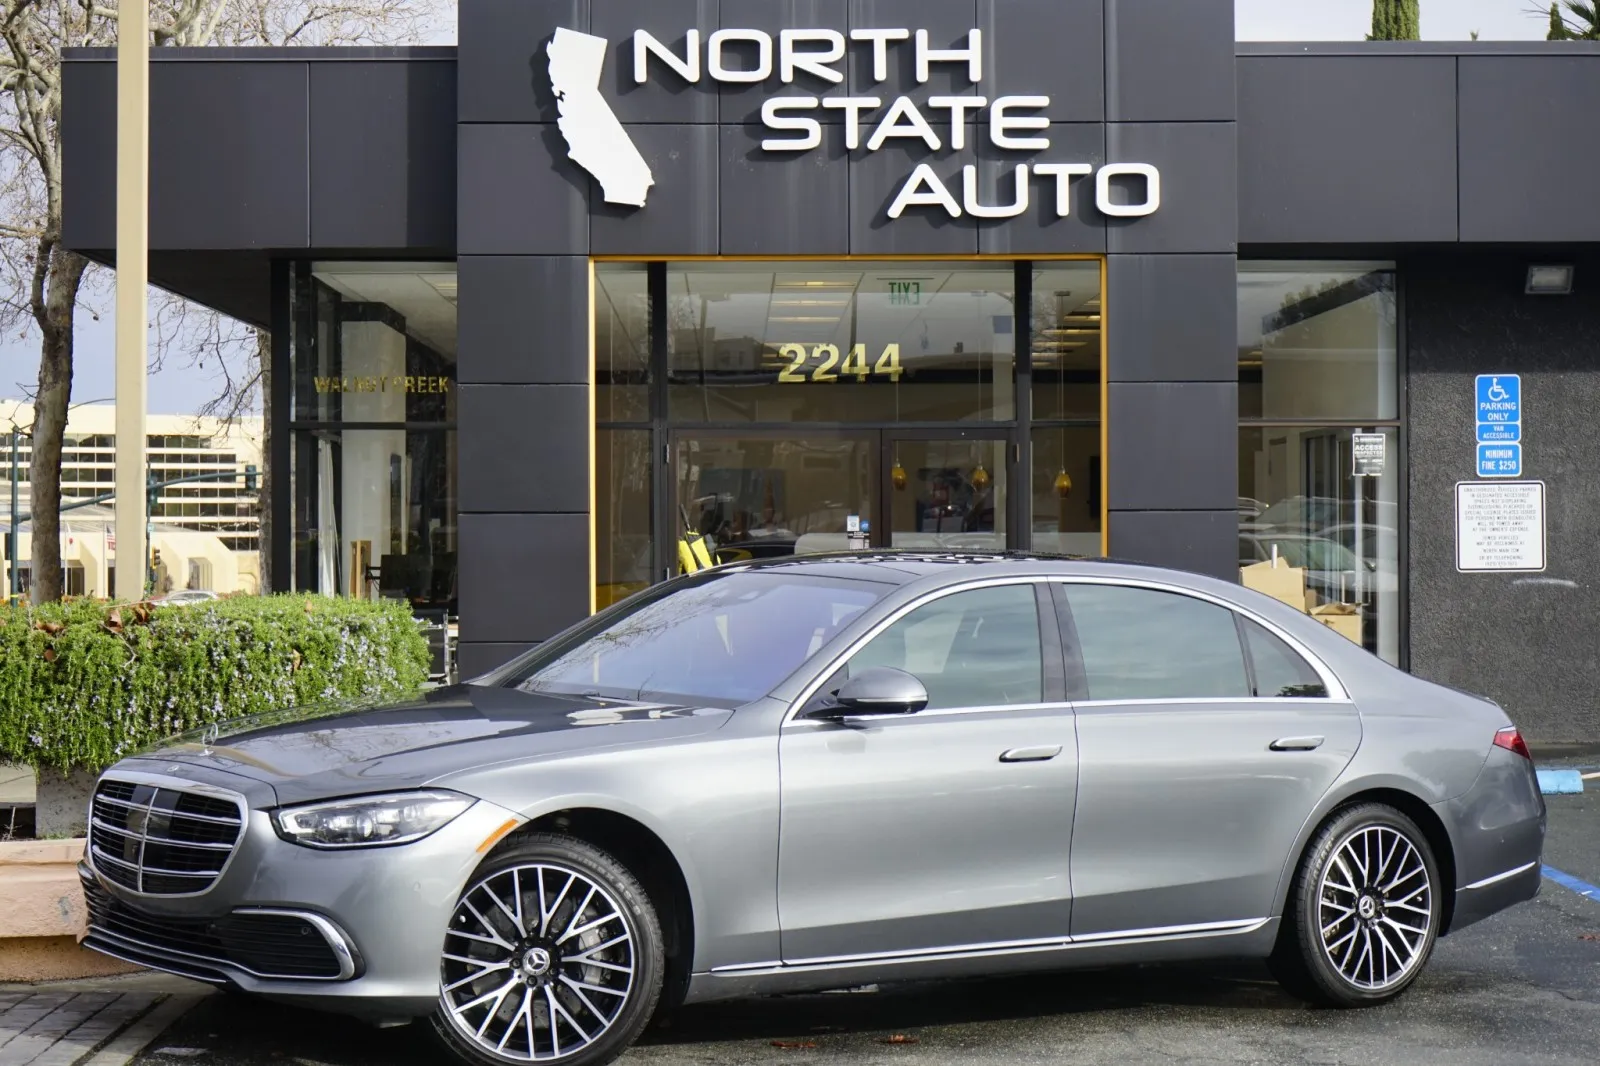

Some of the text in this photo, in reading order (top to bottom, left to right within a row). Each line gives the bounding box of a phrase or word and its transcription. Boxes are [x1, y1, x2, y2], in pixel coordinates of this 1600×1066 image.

[634, 28, 981, 83] NORTH
[761, 95, 1050, 151] STATE
[887, 163, 1160, 218] AUTO
[777, 342, 903, 383] 2244
[313, 376, 449, 393] WALNUT CREEK
[1480, 402, 1517, 411] PARKING
[1487, 412, 1509, 421] ONLY
[1485, 449, 1513, 459] MINIMUM
[1481, 460, 1517, 471] FINE $250
